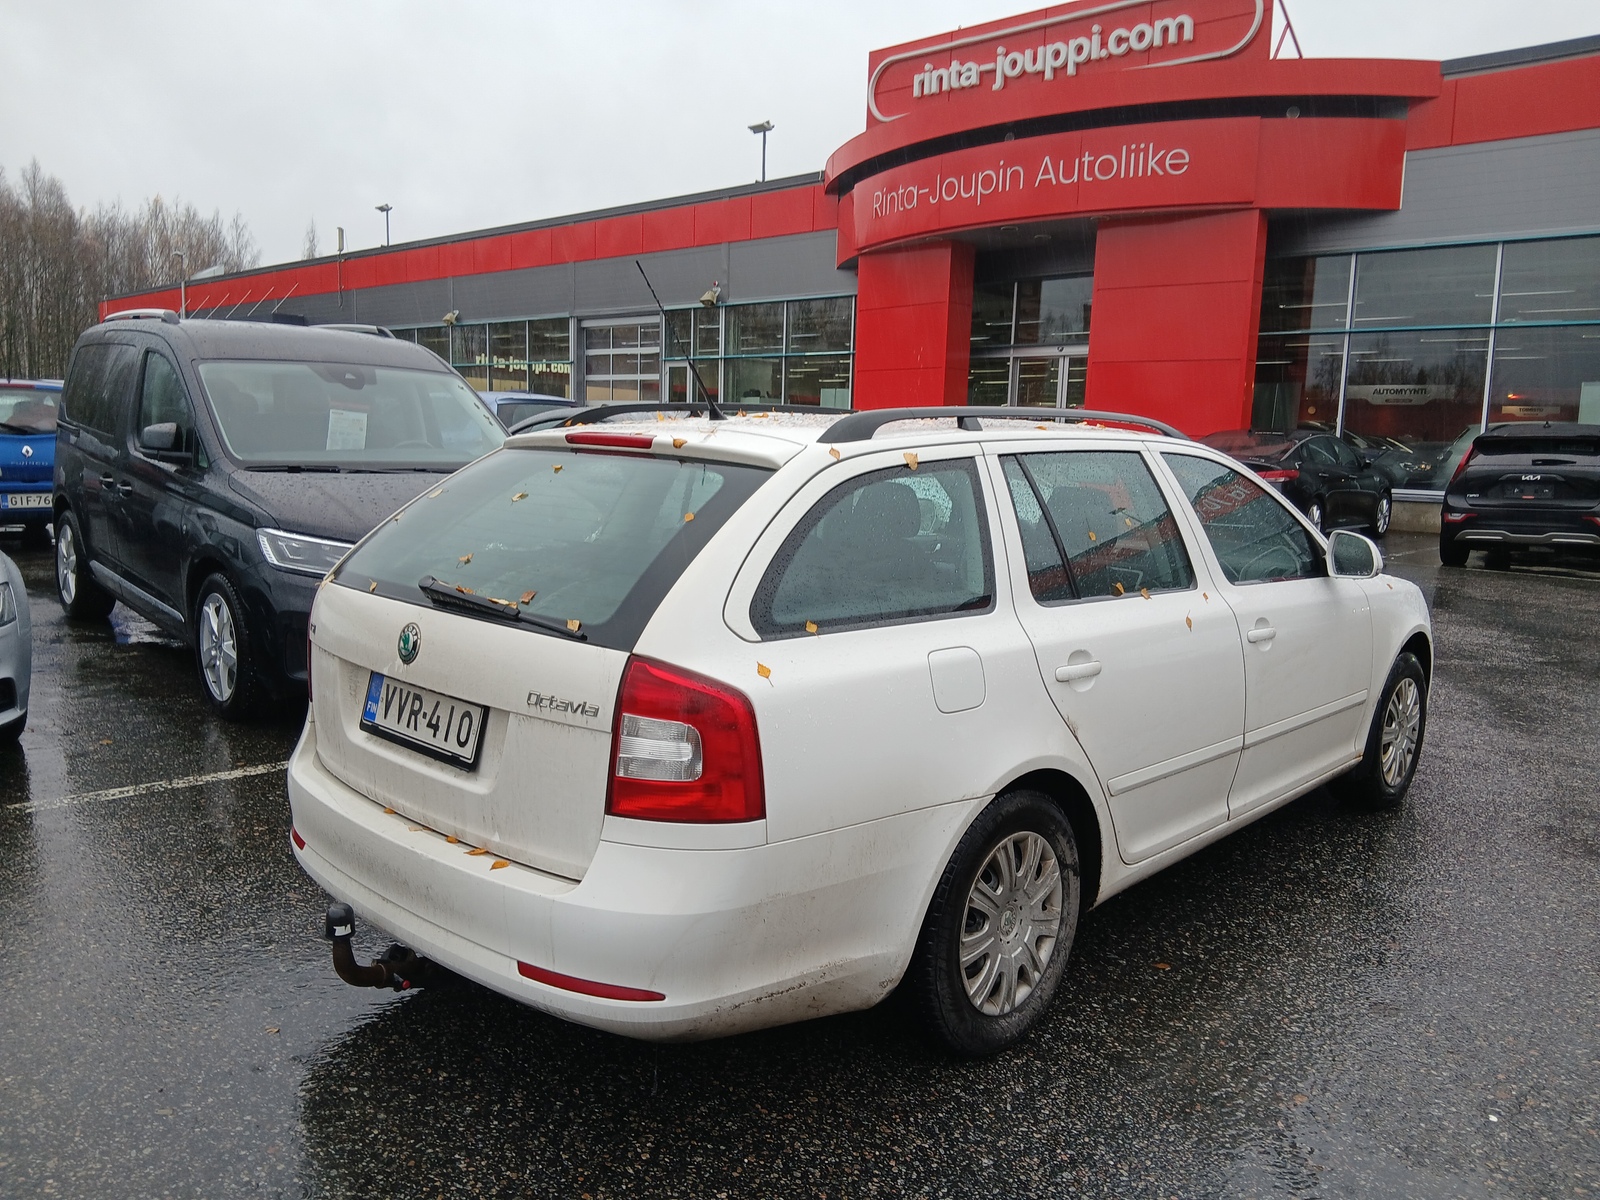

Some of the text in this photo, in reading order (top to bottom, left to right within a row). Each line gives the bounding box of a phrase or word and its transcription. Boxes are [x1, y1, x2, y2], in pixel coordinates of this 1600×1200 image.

[912, 14, 1196, 97] rinta-jouppi.com
[873, 143, 1191, 221] Rinta-Joupin Autoliike
[1373, 388, 1427, 396] AUTOMYYNTI
[367, 701, 377, 714] FIN
[527, 690, 600, 718] Octavia
